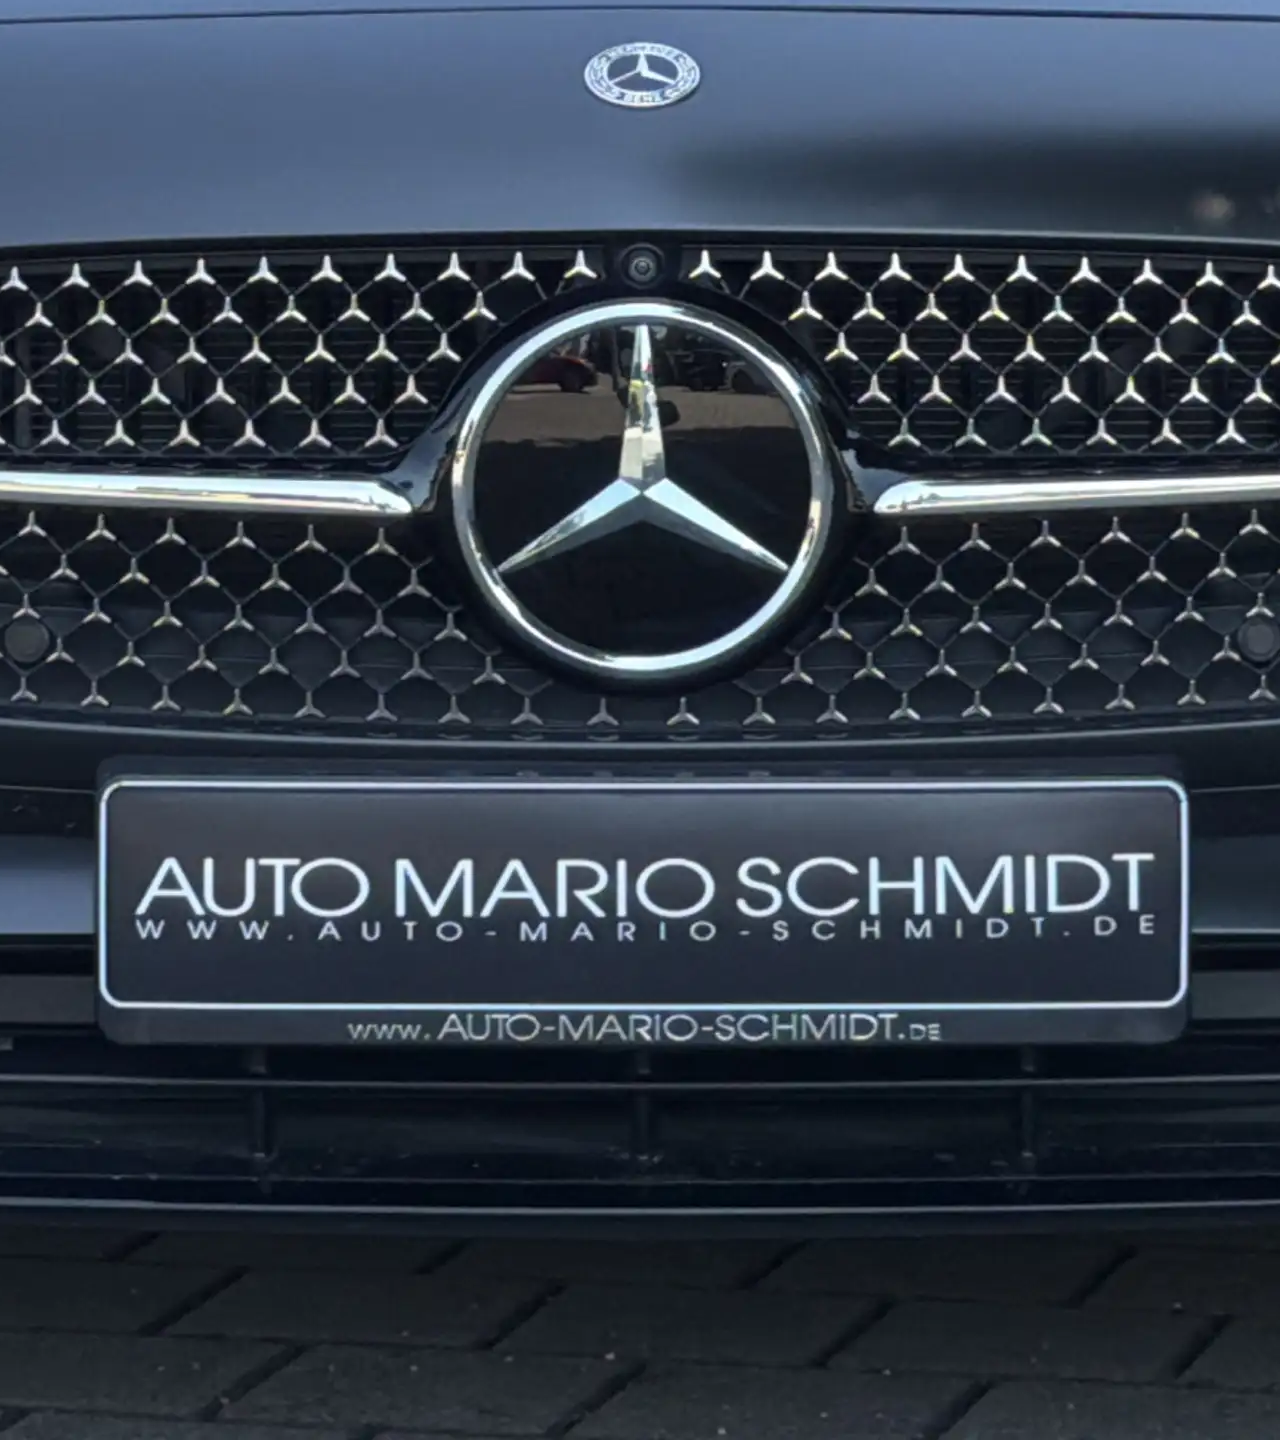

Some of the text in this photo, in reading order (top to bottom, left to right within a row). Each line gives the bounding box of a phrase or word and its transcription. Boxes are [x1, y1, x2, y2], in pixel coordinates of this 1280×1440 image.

[133, 853, 1156, 918] AUTO MARIO SCHMIDT
